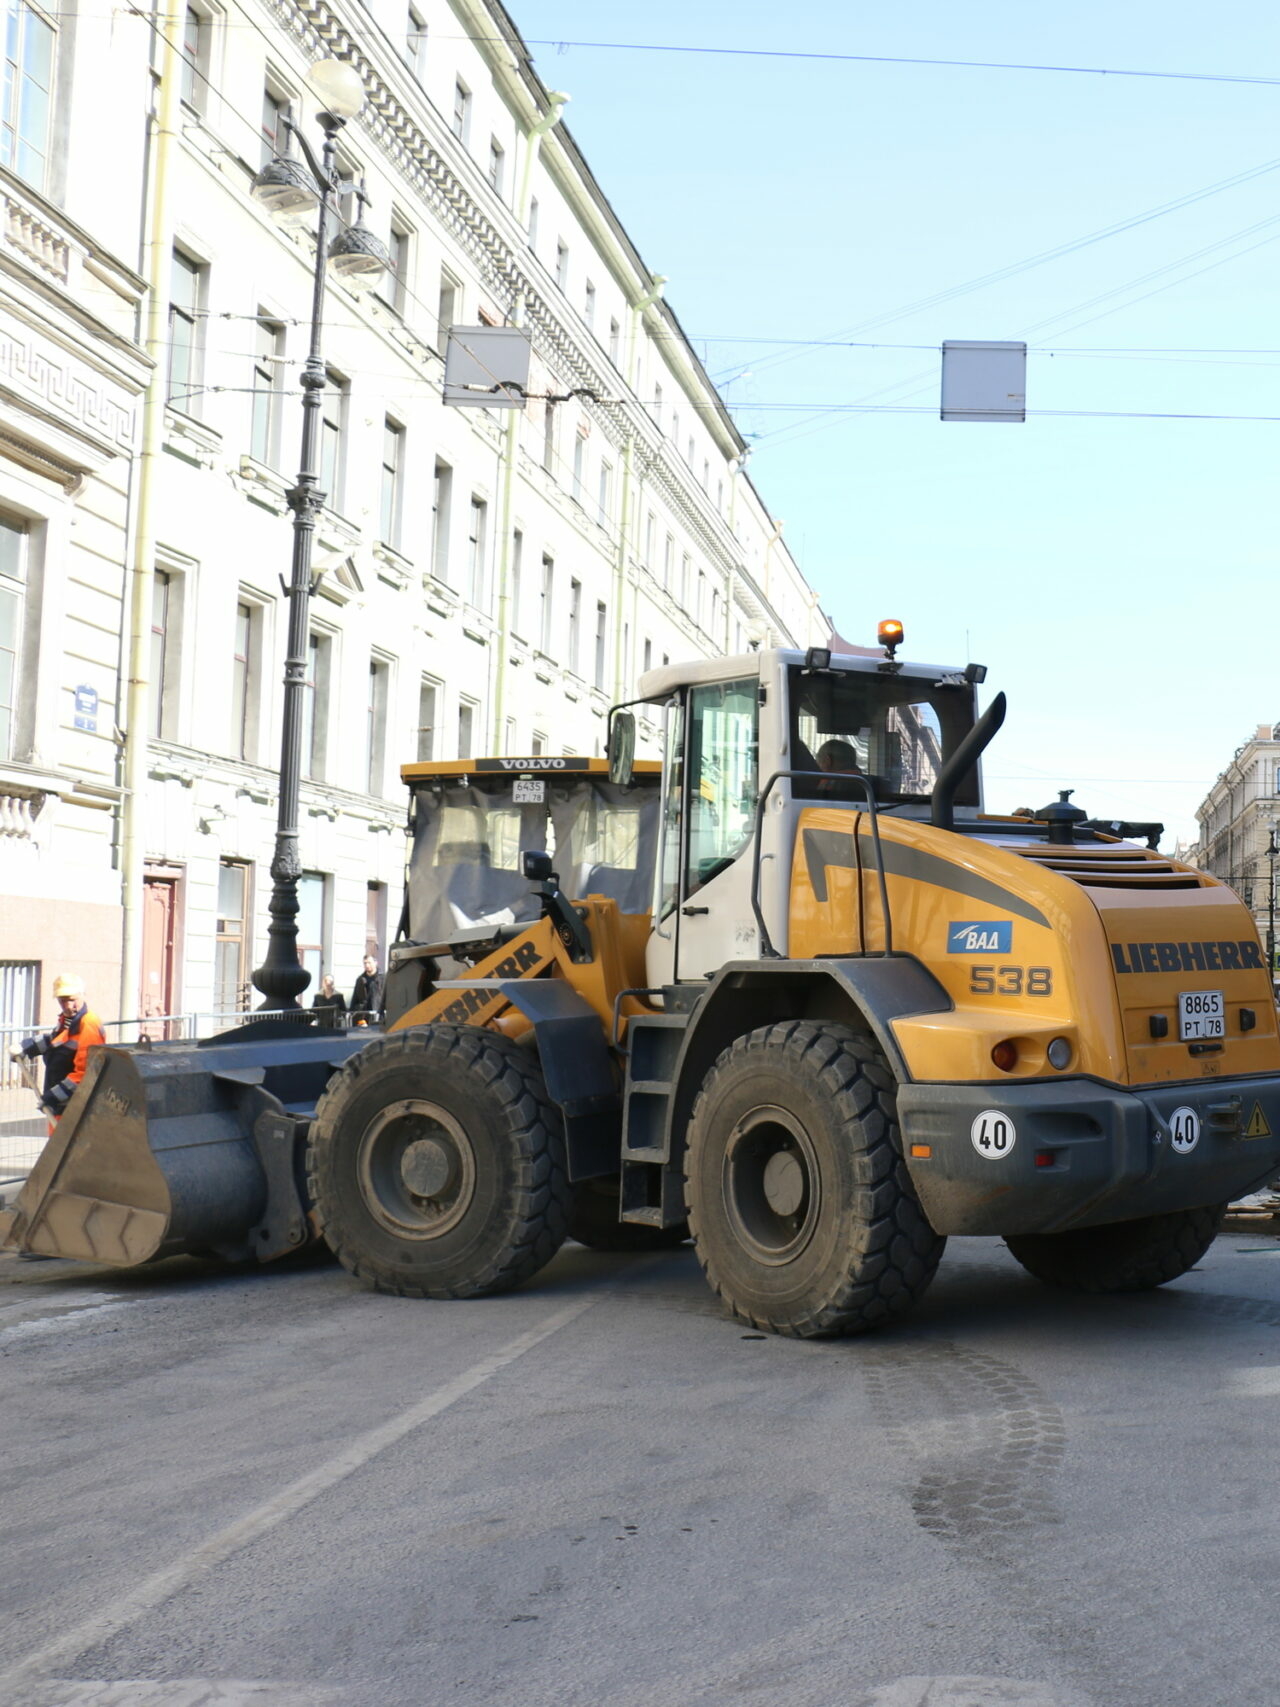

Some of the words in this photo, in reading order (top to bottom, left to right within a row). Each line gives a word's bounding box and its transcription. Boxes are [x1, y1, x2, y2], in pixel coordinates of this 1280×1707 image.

[499, 758, 566, 769] VOLVO
[517, 781, 541, 791] 6435
[532, 793, 542, 802] 78
[965, 931, 999, 950] ВАД
[1111, 941, 1263, 973] LIEBHERR
[970, 964, 1052, 996] 538
[1185, 995, 1219, 1014] 8865
[1208, 1020, 1221, 1034] 78
[979, 1119, 1007, 1150] 40
[1174, 1115, 1194, 1145] 40
